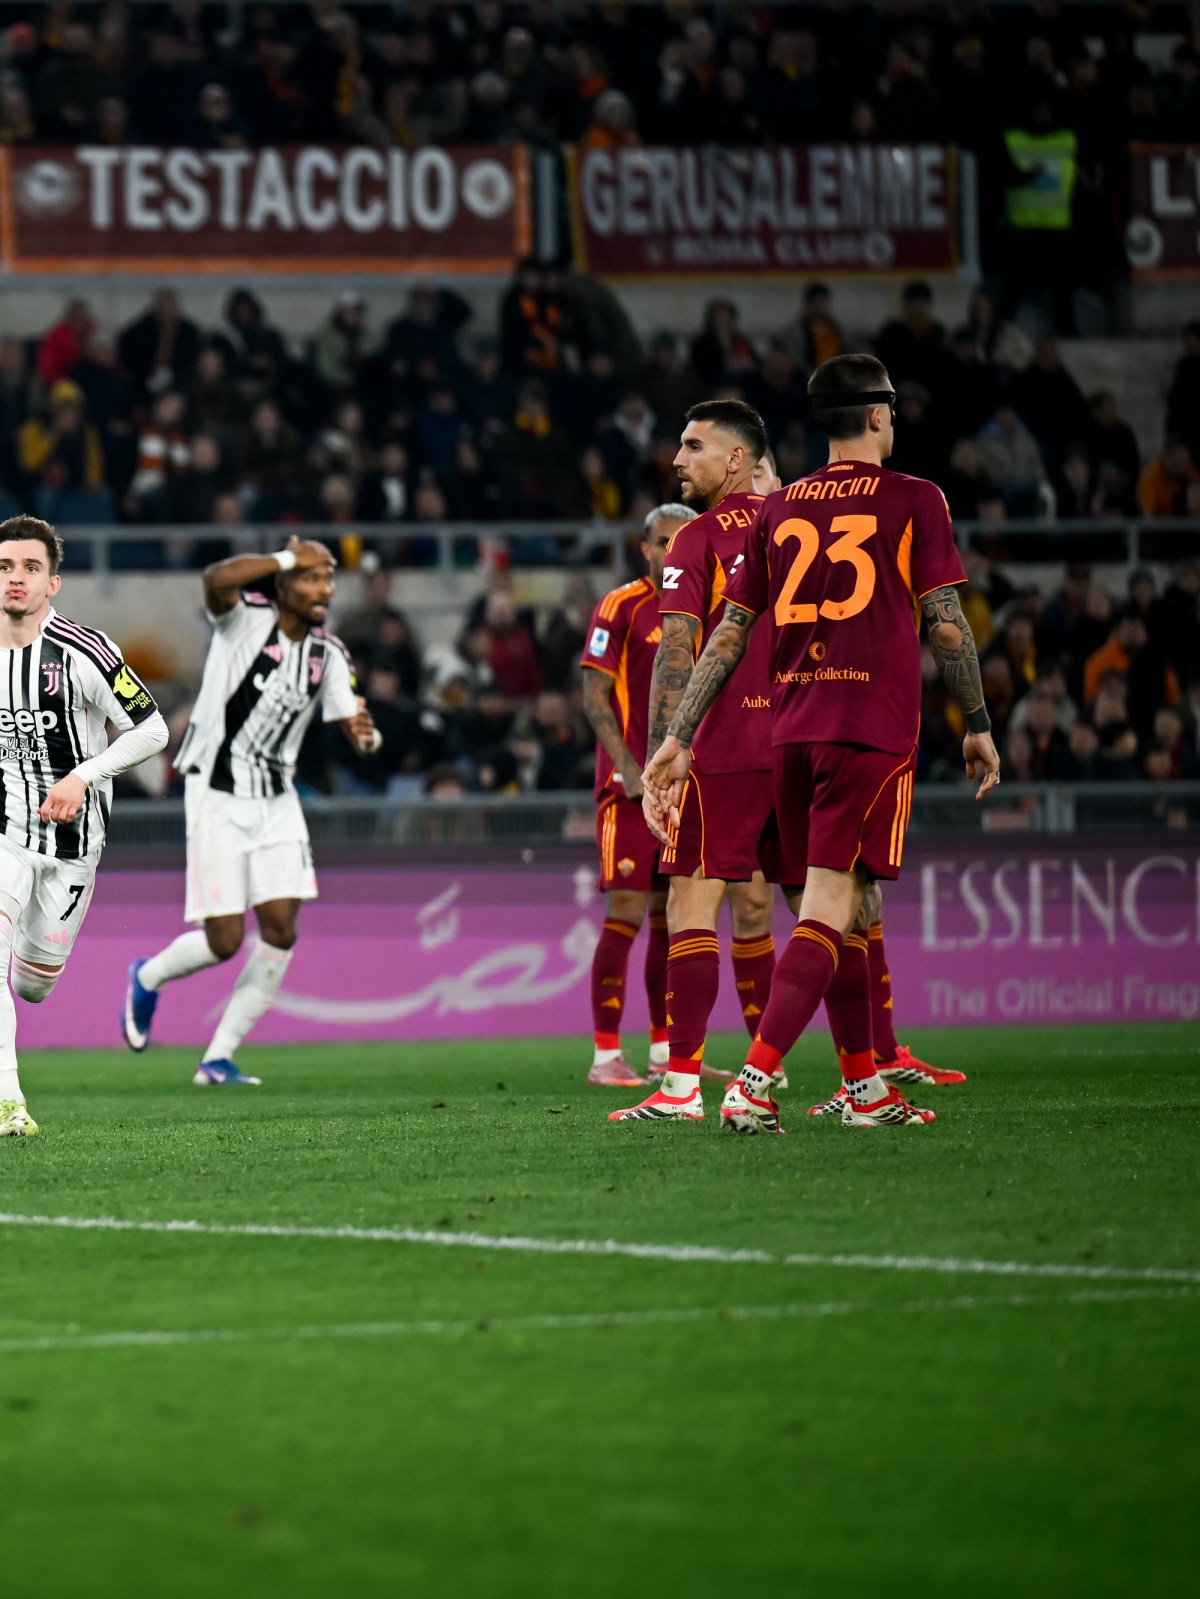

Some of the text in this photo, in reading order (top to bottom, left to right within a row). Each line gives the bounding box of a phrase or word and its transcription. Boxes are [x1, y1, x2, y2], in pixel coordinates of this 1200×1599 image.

[76, 147, 458, 230] TESTACCIO
[785, 476, 880, 502] MANCINI
[715, 508, 758, 531] PEL
[773, 514, 877, 626] 23
[774, 667, 870, 685] Auberge Collection
[741, 693, 771, 708] Aube
[6, 737, 41, 748] VISIT
[60, 885, 85, 921] 7
[921, 855, 1200, 951] ESSENC
[925, 979, 988, 1017] The
[996, 976, 1113, 1016] Official
